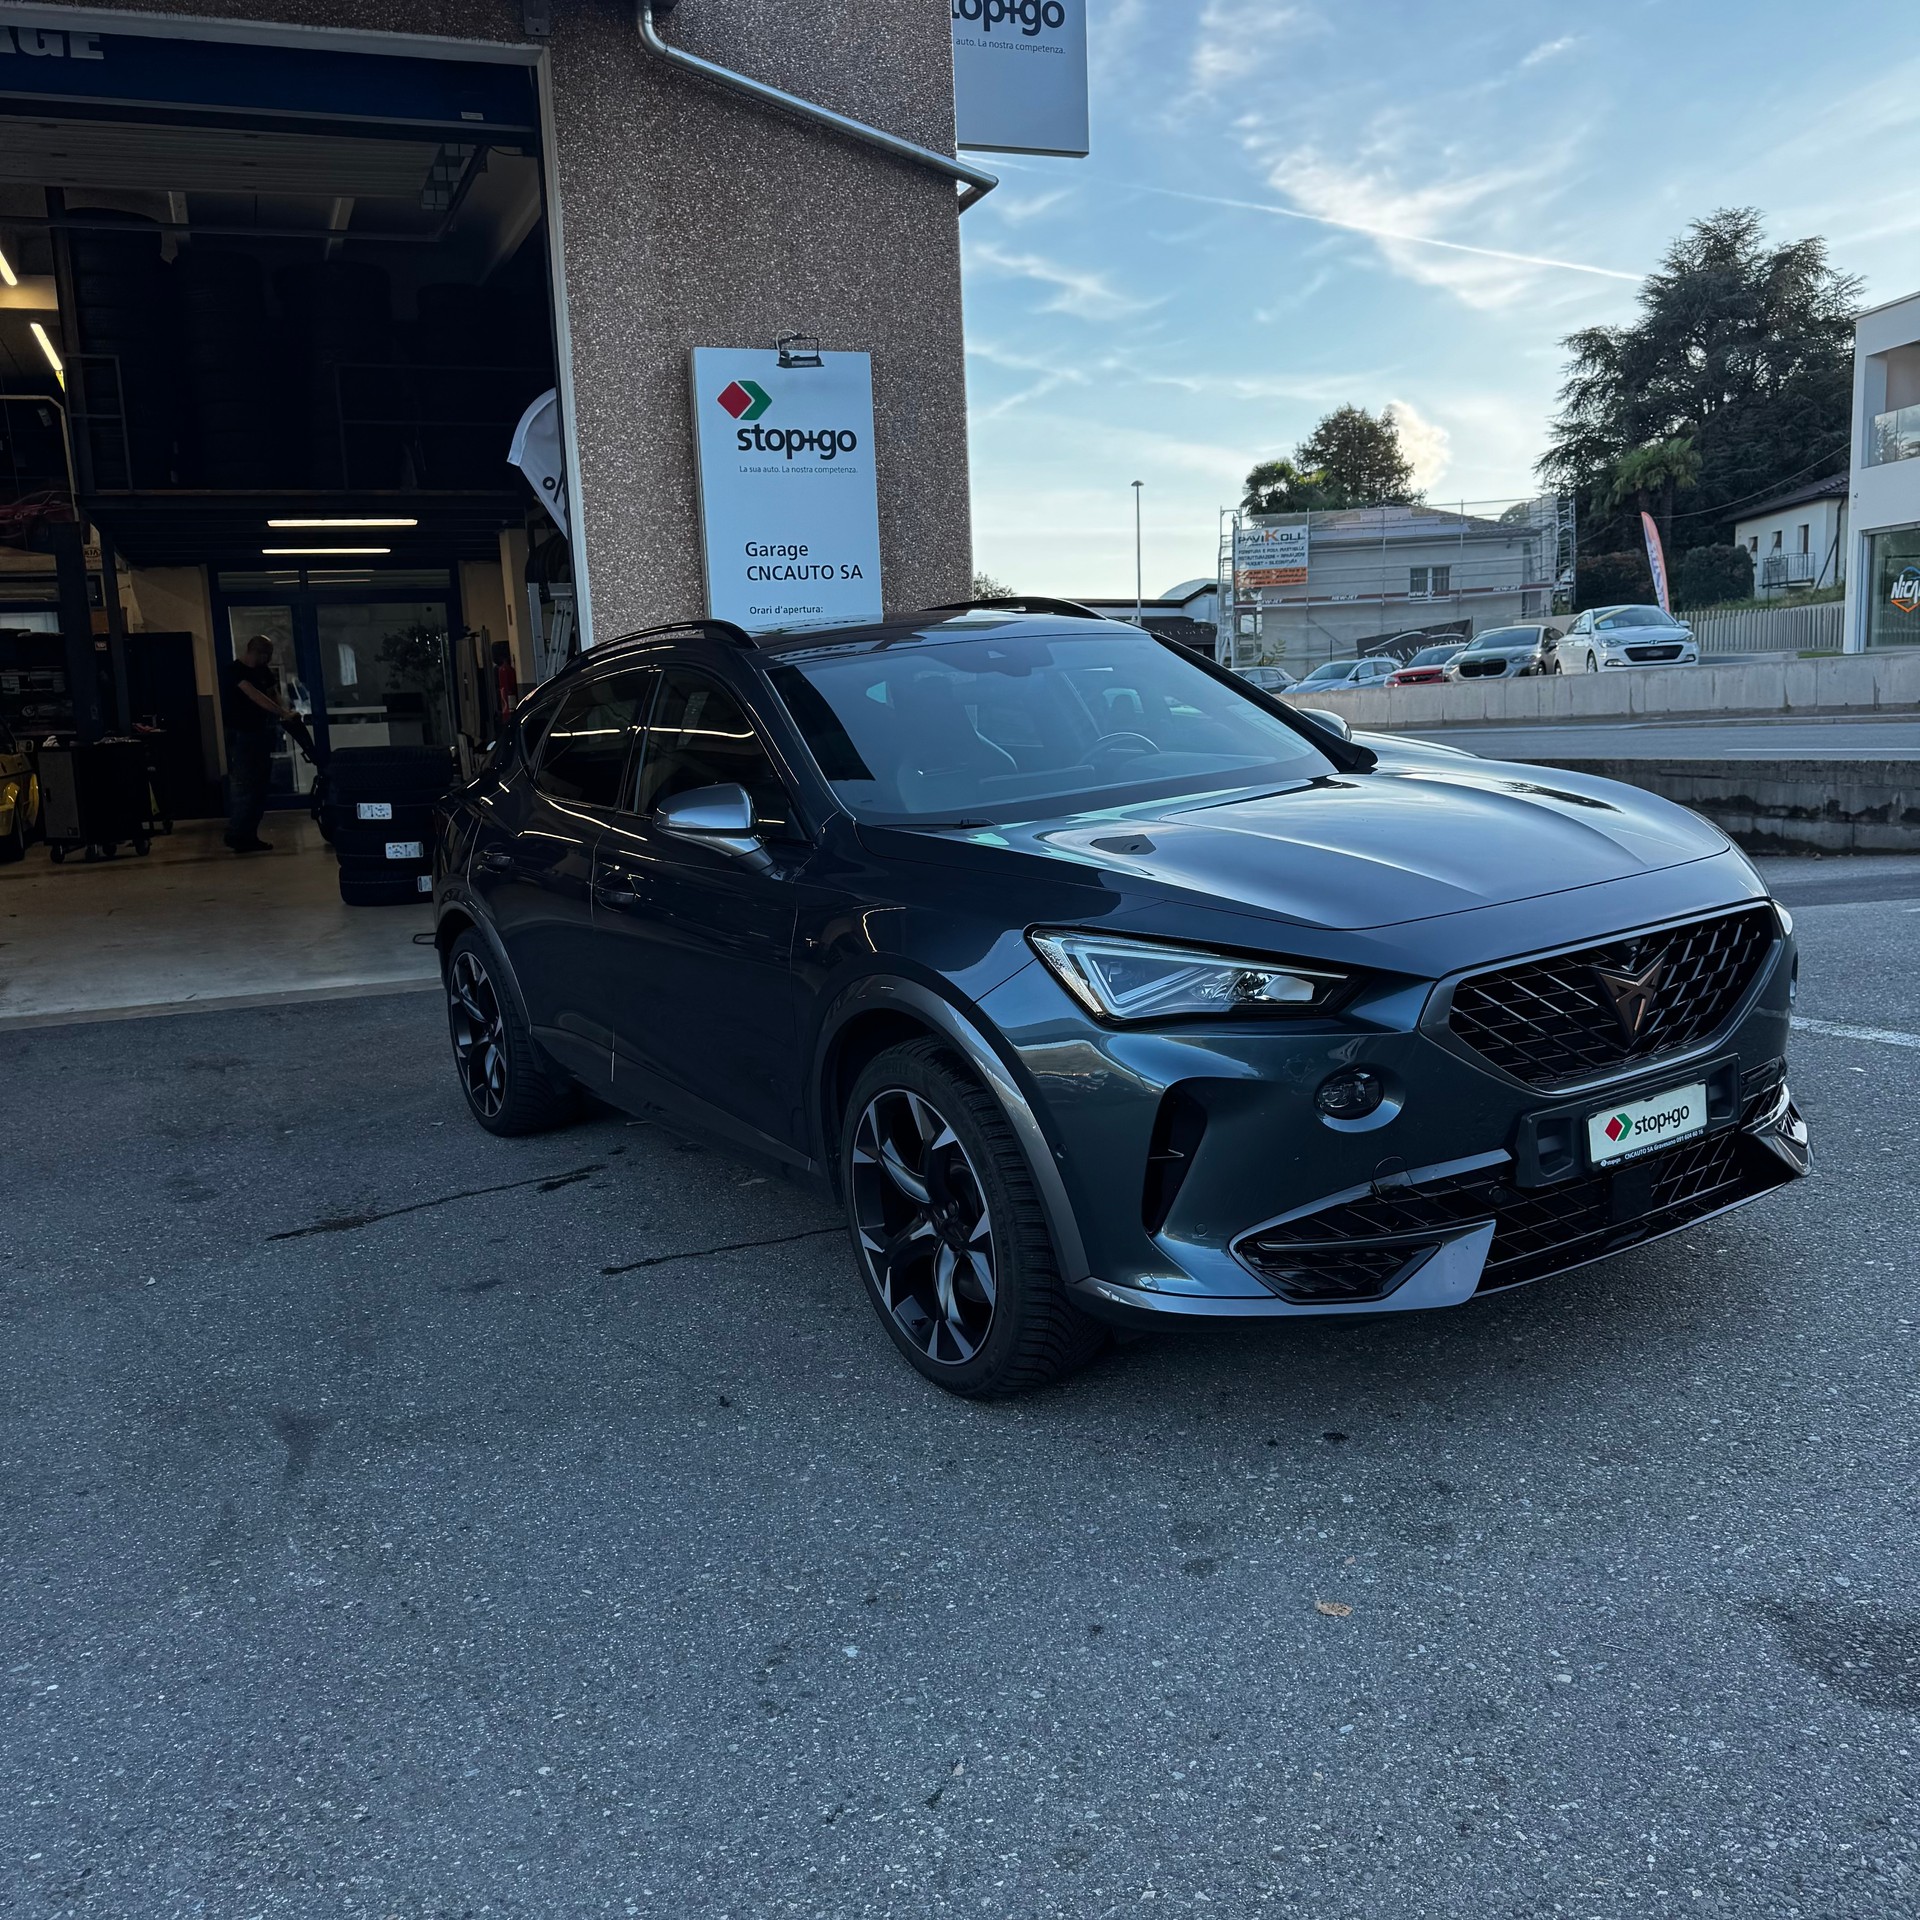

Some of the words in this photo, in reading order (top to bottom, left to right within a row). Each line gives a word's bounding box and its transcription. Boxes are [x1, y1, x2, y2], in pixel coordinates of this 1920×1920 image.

[952, 0, 1065, 36] op+go
[956, 38, 976, 47] auto.
[978, 39, 987, 48] La
[989, 41, 1014, 50] nostra
[1015, 43, 1066, 54] competenza.
[737, 423, 857, 460] stop+go
[814, 467, 858, 475] competenza.
[745, 541, 809, 561] Garage
[747, 564, 834, 581] CNCAUTO
[840, 564, 863, 579] SA
[749, 605, 773, 615] Orari
[775, 605, 824, 616] d'apertura:
[1635, 1105, 1689, 1135] stop+go
[1624, 1148, 1647, 1160] CNCAUTO
[1647, 1145, 1653, 1153] SA
